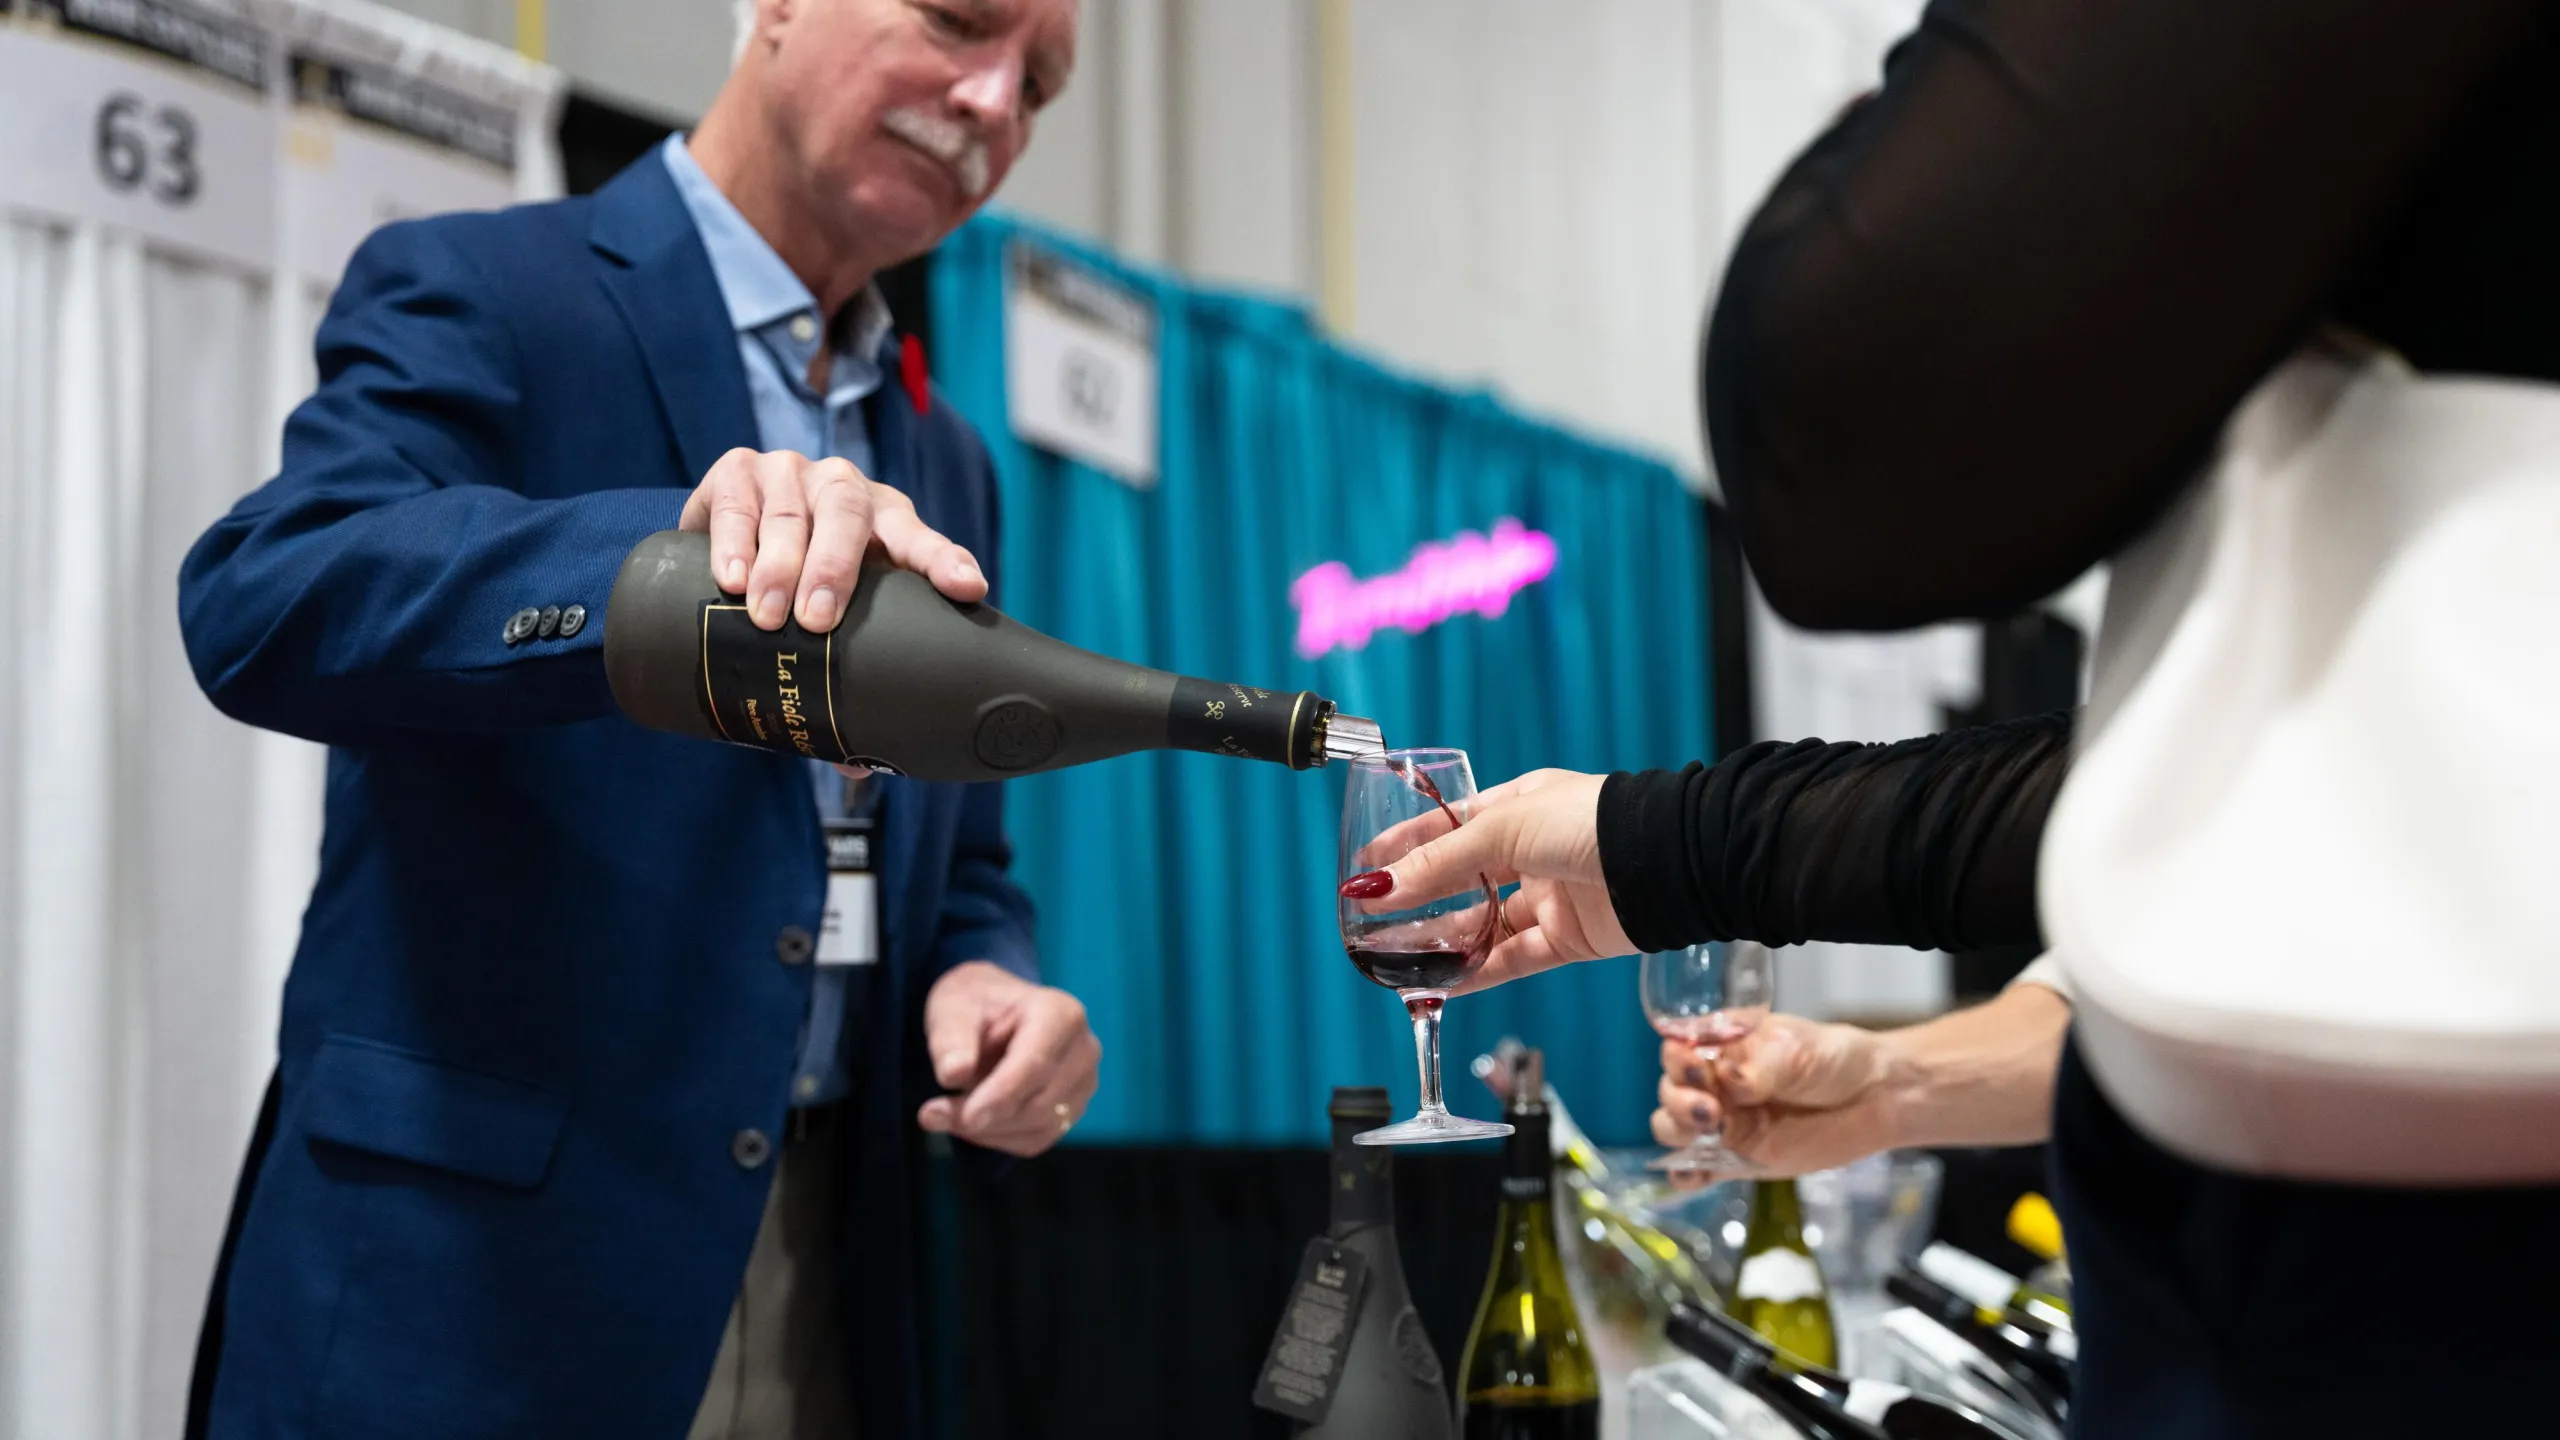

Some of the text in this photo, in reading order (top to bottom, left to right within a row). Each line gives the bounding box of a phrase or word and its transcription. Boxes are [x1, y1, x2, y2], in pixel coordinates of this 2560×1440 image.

[95, 90, 202, 204] 63
[777, 651, 798, 681] La
[779, 684, 807, 726] Fiole
